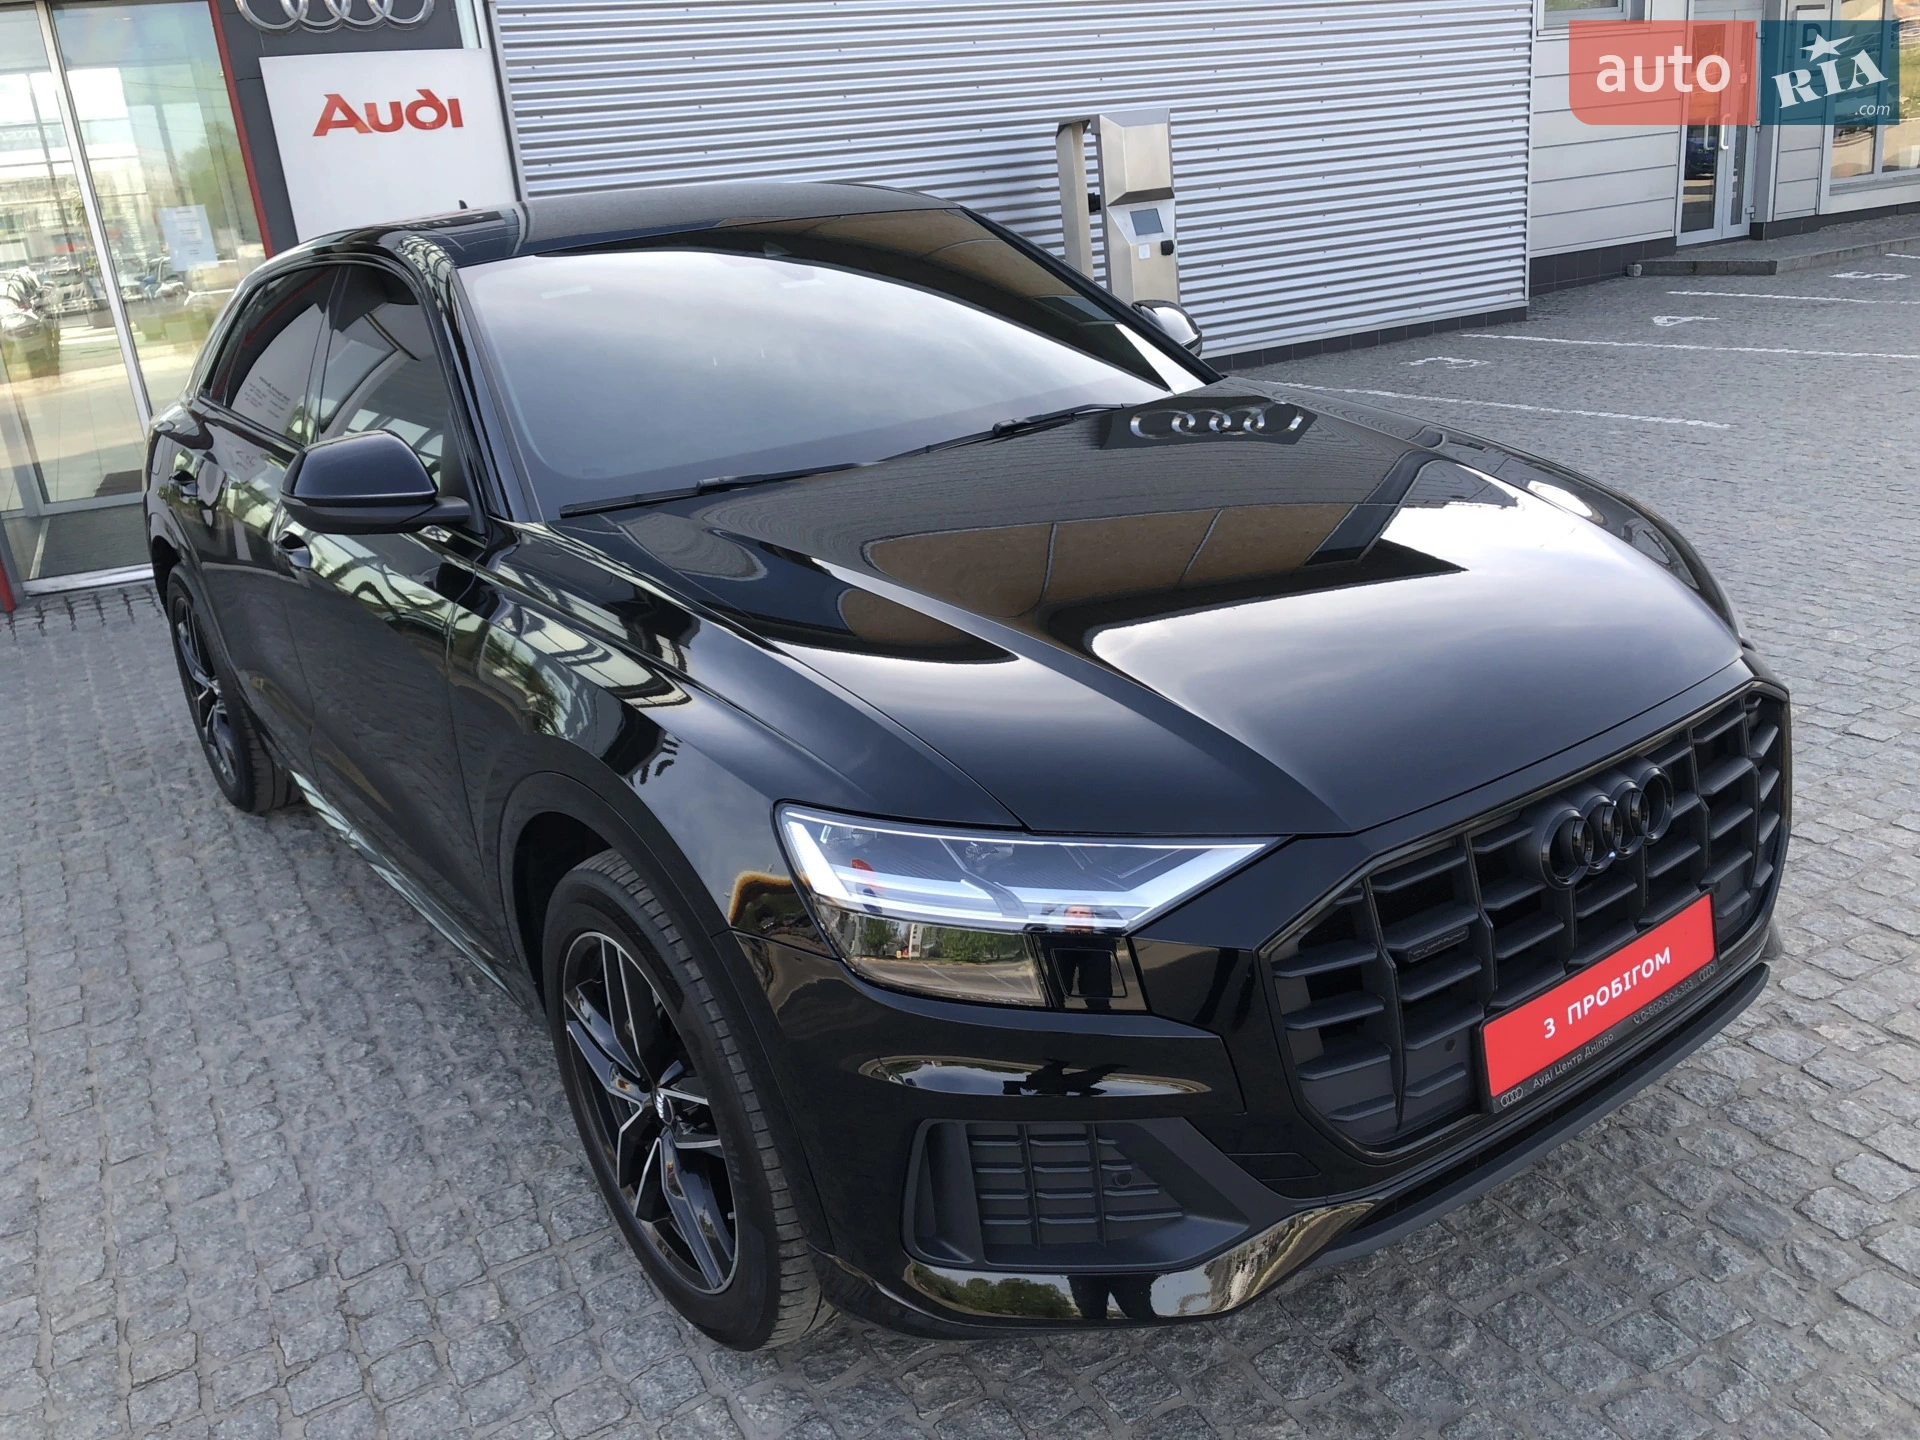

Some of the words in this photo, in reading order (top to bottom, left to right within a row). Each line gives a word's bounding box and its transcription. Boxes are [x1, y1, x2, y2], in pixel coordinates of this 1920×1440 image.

[312, 88, 464, 137] Audi
[1567, 946, 1671, 1025] ПРОБІГОМ
[1533, 1070, 1553, 1088] Ауді
[1554, 1053, 1583, 1076] Центр
[1585, 1033, 1614, 1059] Дніпро
